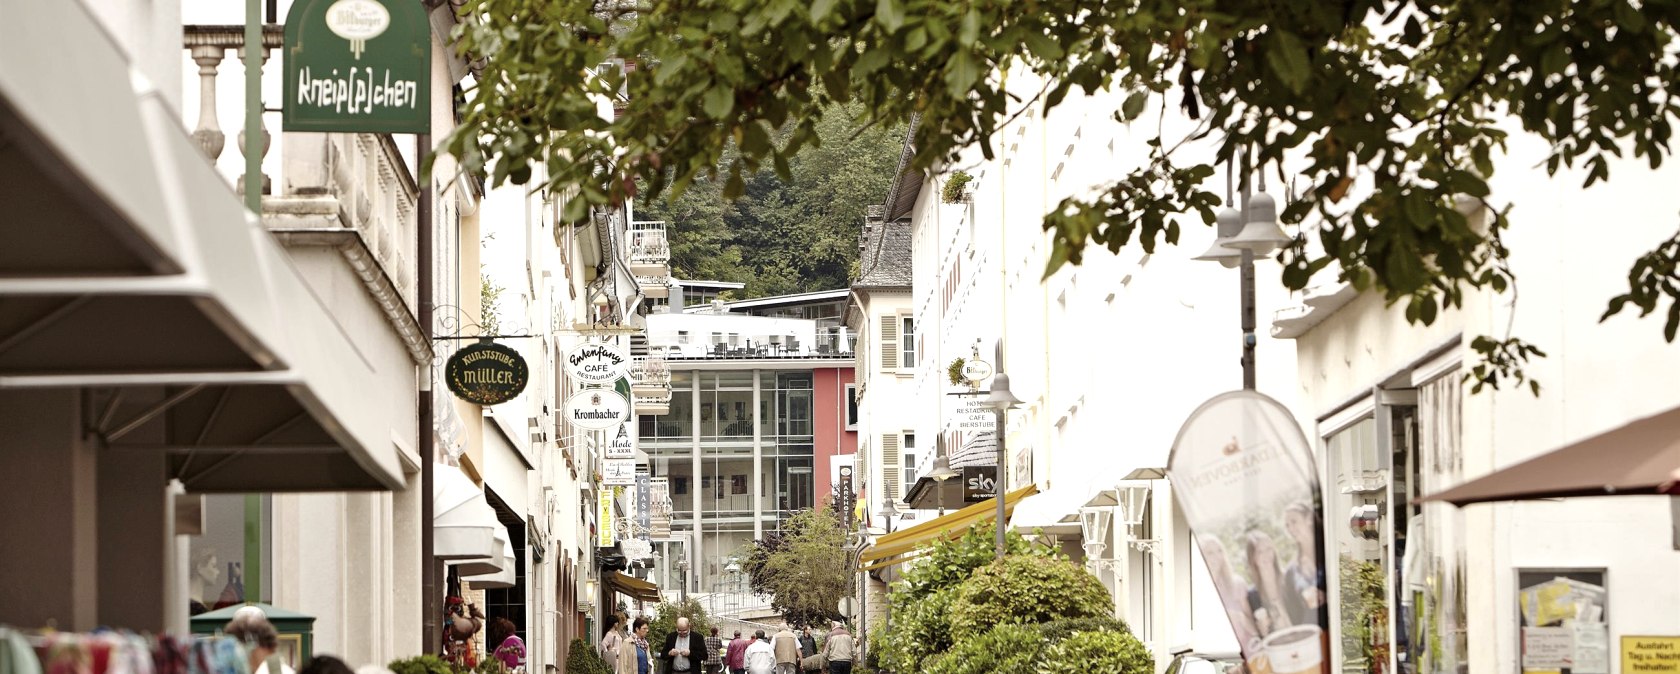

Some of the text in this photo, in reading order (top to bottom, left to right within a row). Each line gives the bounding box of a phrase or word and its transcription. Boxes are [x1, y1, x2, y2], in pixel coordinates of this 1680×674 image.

[298, 66, 416, 114] Kneip[p]chen
[570, 346, 624, 366] Entenfang
[577, 370, 617, 380] RESTAURANT
[574, 408, 620, 419] Krombacher
[608, 440, 632, 448] Mode
[968, 474, 997, 493] sky
